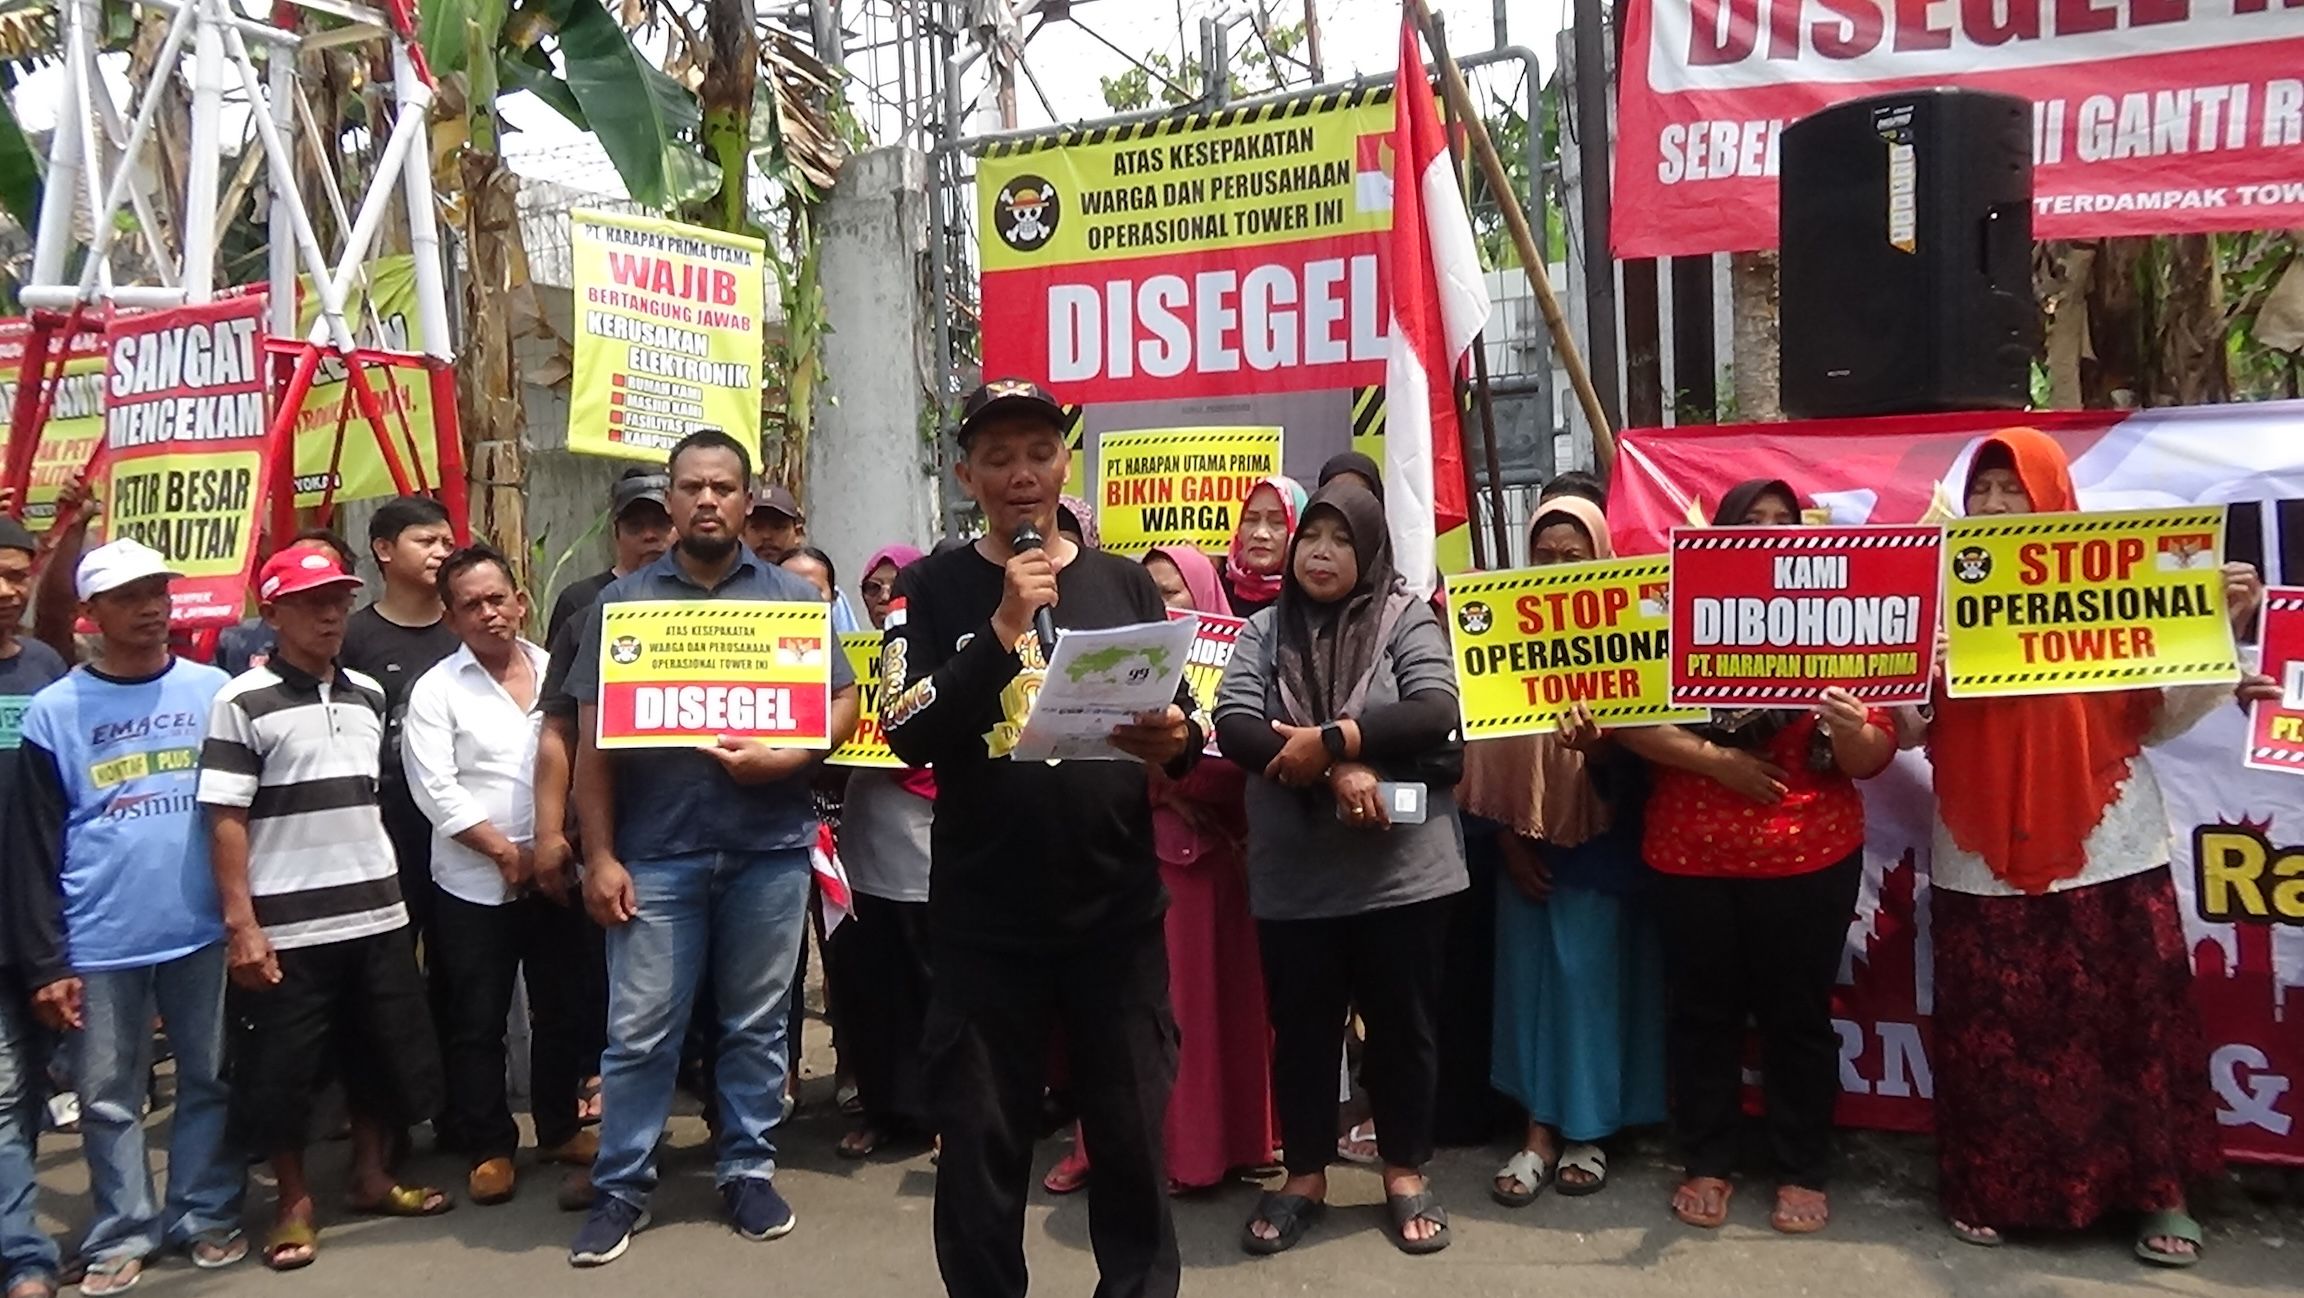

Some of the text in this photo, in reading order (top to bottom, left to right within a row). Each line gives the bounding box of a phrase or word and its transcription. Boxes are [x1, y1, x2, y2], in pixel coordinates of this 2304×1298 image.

[2077, 83, 2250, 163] GANTI
[1113, 127, 1314, 176] ATAS KESEPAKATAN
[1080, 160, 1350, 216] WARGA DAN PERUSAHAAN
[2034, 188, 2228, 214] TERDAMPAK
[606, 226, 665, 251] HARAPAN
[668, 236, 707, 259] PRIMA
[711, 244, 752, 267] UTAMA
[1088, 199, 1343, 251] OPERASIONAL TOWER INI
[609, 251, 737, 306] WAJIB
[588, 287, 751, 331] BERTANGUNG JAWAB
[1048, 253, 1392, 383] DISEGEL
[587, 310, 710, 358] KERUSAKAN
[111, 316, 257, 398] SANGAT
[628, 345, 752, 389] ELEKTRONIK
[626, 392, 703, 420] MASJID KAMI
[627, 374, 703, 402] RUMAH KAMI
[108, 391, 265, 449] MENCEKAM
[1107, 453, 1271, 477] PT. HARAPAN UTAMA PRIMA
[114, 468, 251, 519] PETIR BESAR
[1106, 477, 1260, 507] BIKIN GADU
[1142, 505, 1230, 533] WARGA
[1773, 556, 1847, 590] KAMI
[2018, 537, 2146, 587] STOP
[1516, 586, 1630, 635] STOP
[1693, 597, 1921, 648] DIBOHONGI
[1956, 583, 2214, 629] OPERASIONAL
[649, 642, 771, 653] WARGA DAN PERUSAHAAN
[665, 625, 755, 637] ATAS KESEPAKATAN
[2018, 627, 2157, 666] TOWER
[652, 659, 716, 670] OPERASIONAL
[720, 659, 752, 670] TOWER
[1687, 652, 1918, 679] PT. HARAPAN UTAMA PRIMA
[633, 685, 798, 731] DISEGEL
[1521, 668, 1641, 707] TOWER
[92, 712, 197, 745] EMACEL
[158, 749, 191, 770] PLUS
